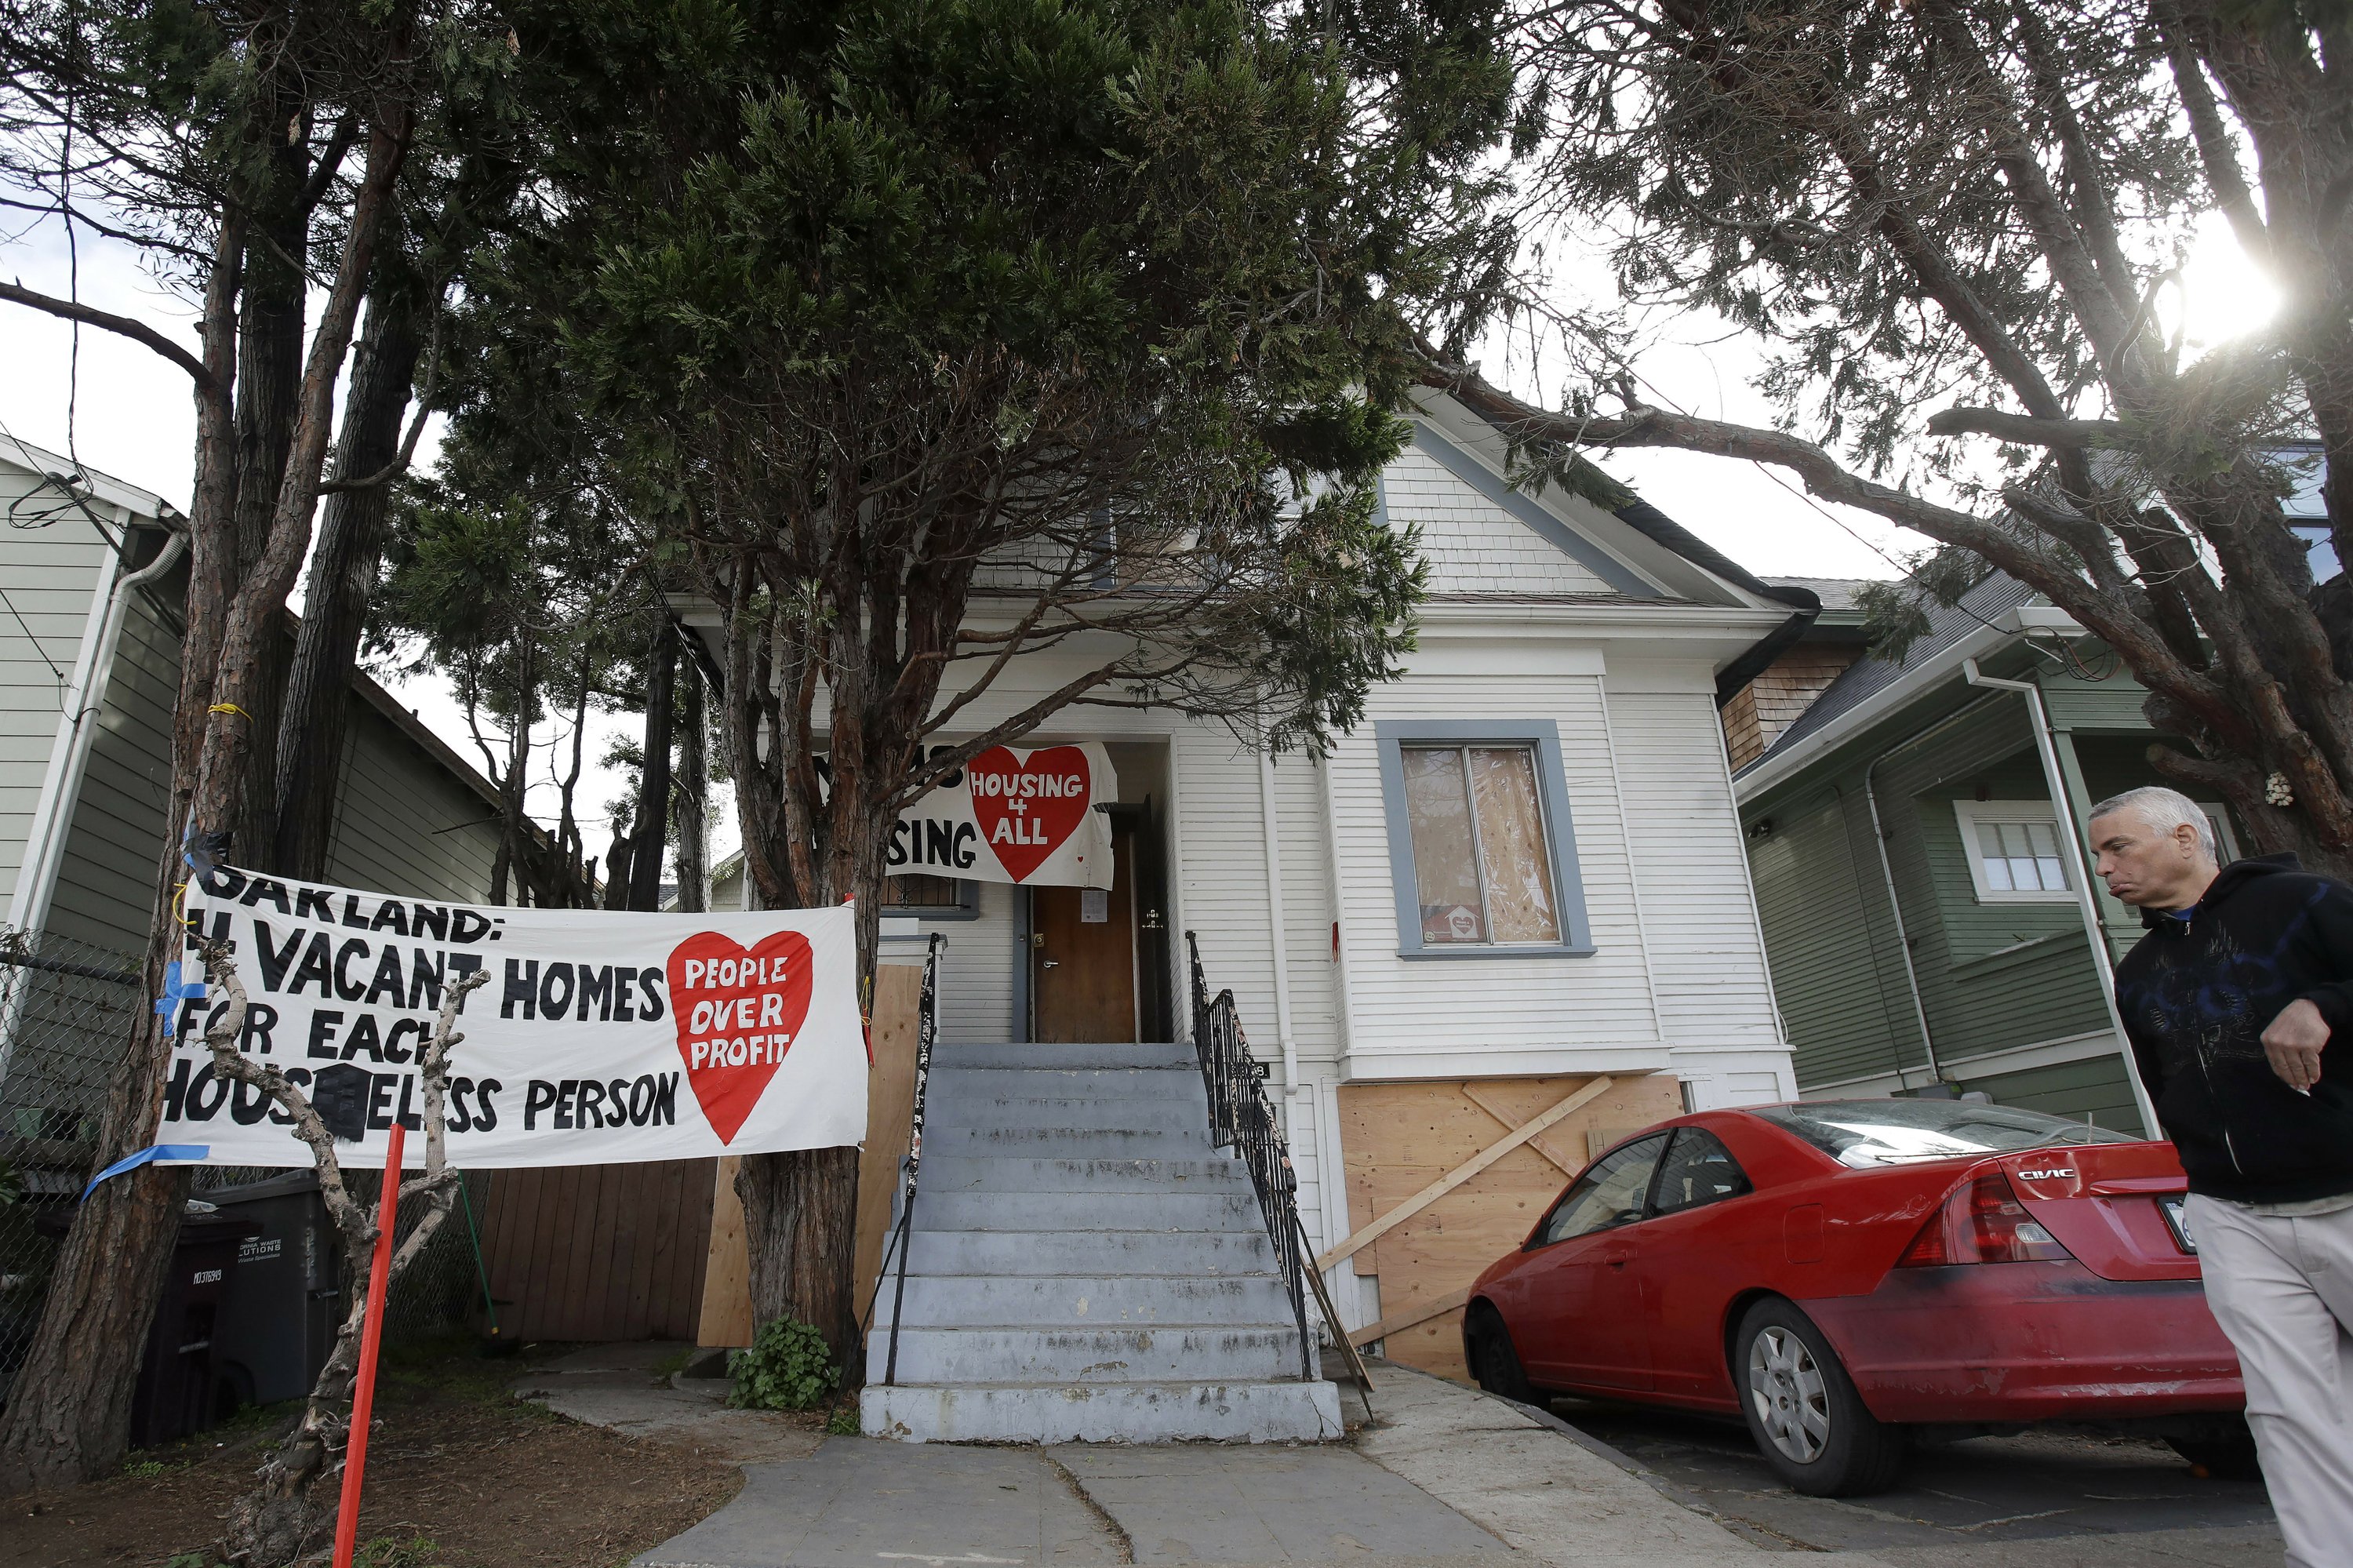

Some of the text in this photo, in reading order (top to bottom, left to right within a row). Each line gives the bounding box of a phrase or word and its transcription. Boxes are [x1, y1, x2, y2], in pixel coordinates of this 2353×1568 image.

[970, 772, 1083, 798] HOUSING
[1008, 799, 1027, 816] 4
[991, 817, 1048, 845] ALL
[254, 919, 482, 1015] VACANT
[500, 959, 664, 1022] HOMES
[684, 956, 788, 990] PEOPLE
[689, 993, 784, 1035] OVER
[690, 1034, 790, 1070] PROFIT
[524, 1071, 679, 1130] PERSON
[2017, 1169, 2075, 1181] CIVIC
[238, 1244, 281, 1257] UTIONS
